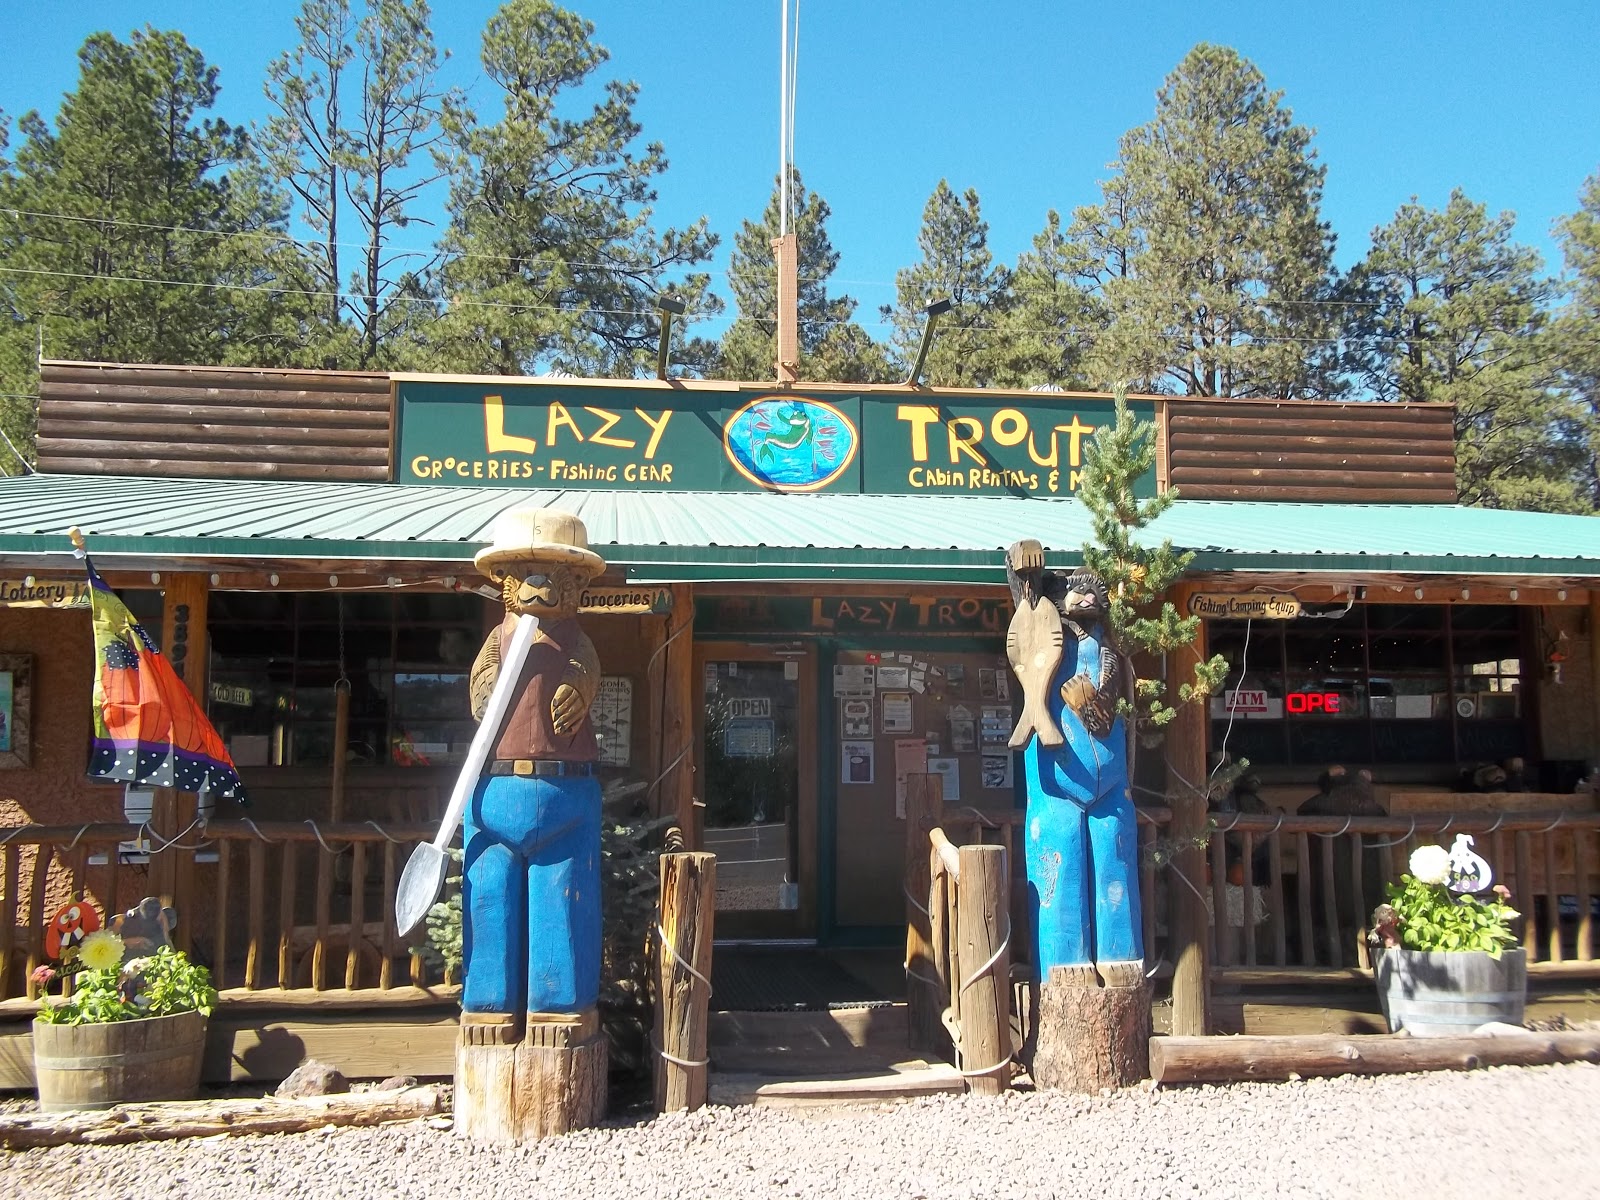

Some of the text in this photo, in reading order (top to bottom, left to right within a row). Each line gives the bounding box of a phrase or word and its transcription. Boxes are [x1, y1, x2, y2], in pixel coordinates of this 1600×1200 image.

[483, 395, 673, 459] LAZY
[623, 463, 673, 483] GEAR
[1048, 469, 1060, 491] &
[0, 581, 66, 603] Lottery
[580, 590, 650, 608] Groceries
[812, 598, 897, 630] LAZY
[732, 700, 769, 717] OPEN
[1229, 692, 1264, 705] ATM
